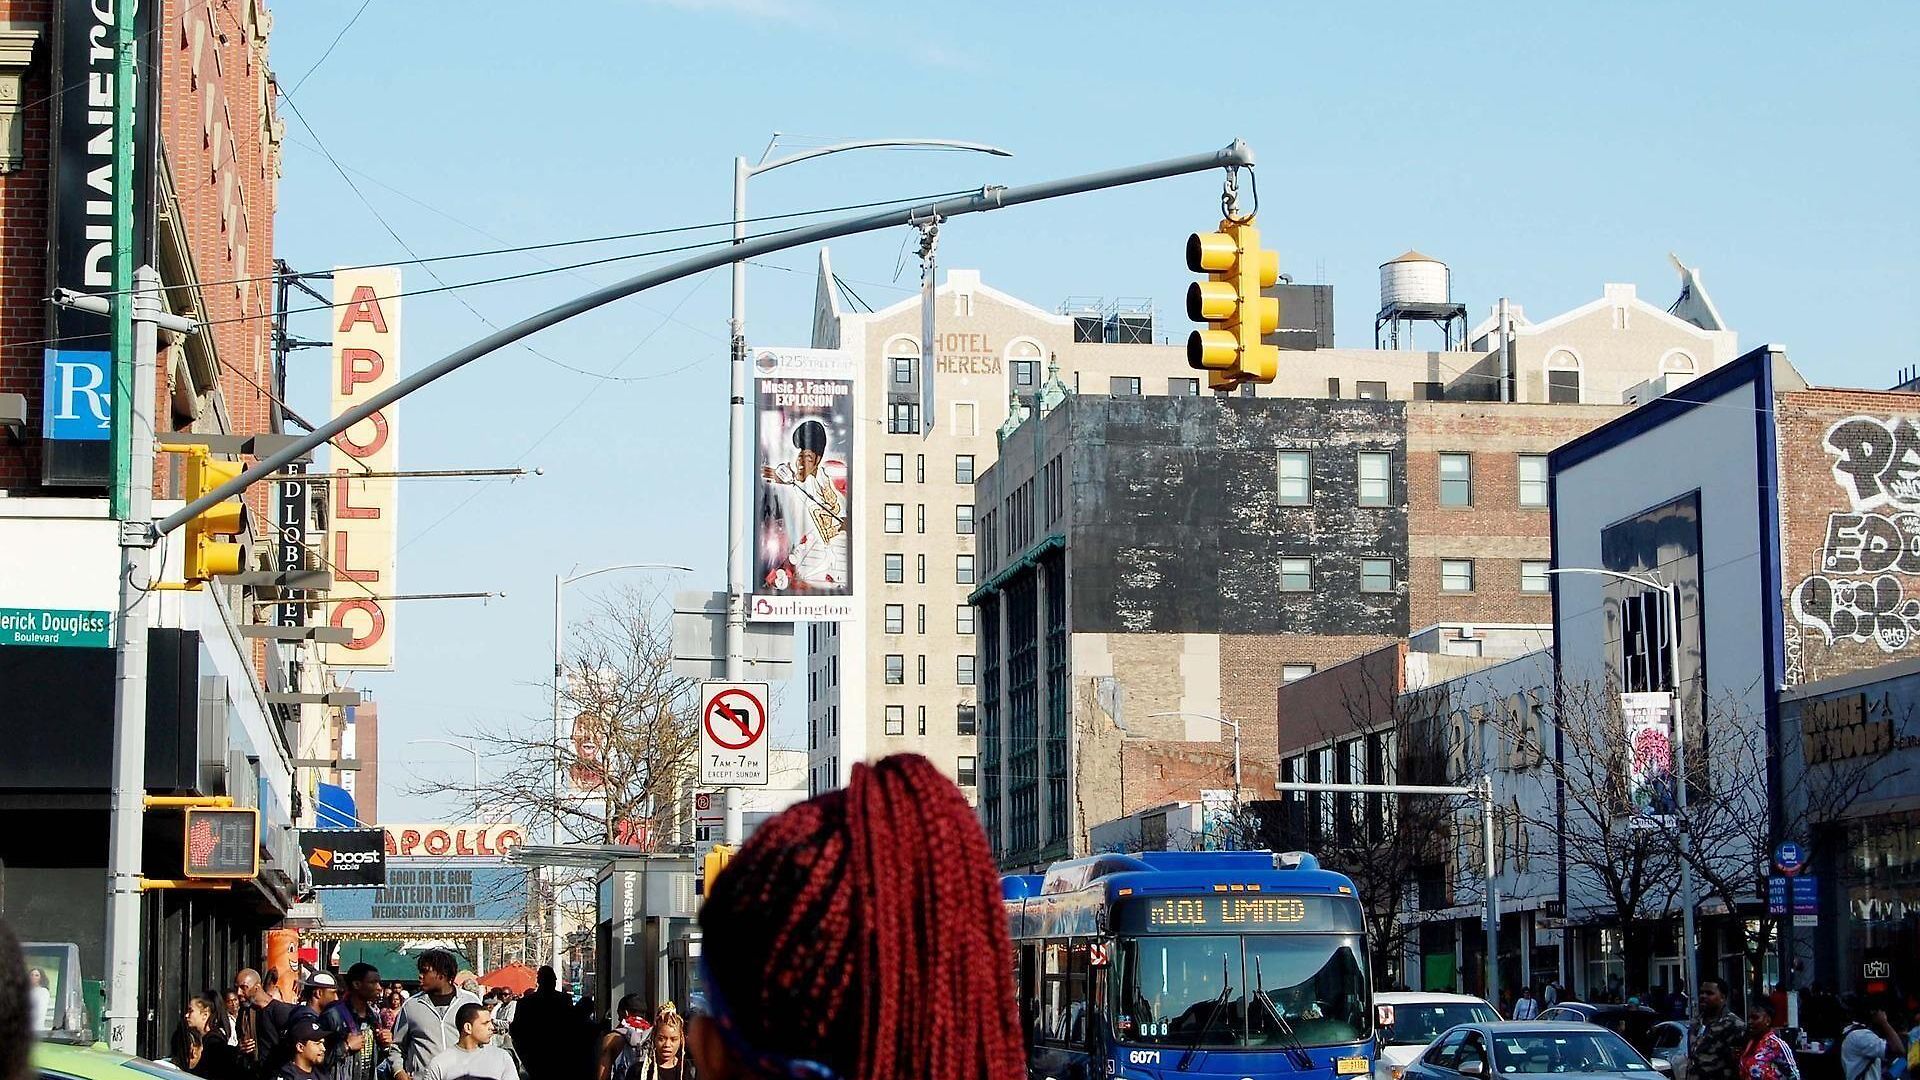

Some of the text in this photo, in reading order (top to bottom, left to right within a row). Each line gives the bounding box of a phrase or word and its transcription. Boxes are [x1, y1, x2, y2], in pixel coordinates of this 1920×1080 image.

[936, 355, 1002, 375] HERESA
[761, 380, 848, 396] Music & Fashion
[775, 394, 834, 407] EXPLOSION
[330, 285, 389, 651] APOLLO
[754, 599, 849, 619] Burlington
[0, 611, 104, 637] erick Douglass
[14, 631, 60, 644] Boulevard
[707, 771, 761, 779] EXCEPT SUNDAY
[385, 829, 522, 856] APOLLO
[333, 849, 381, 864] boost
[333, 863, 360, 871] mobile
[389, 870, 473, 885] GOOD OR BE GONE
[374, 886, 473, 904] AMATEUR NIGHT
[371, 905, 476, 919] WEDNESDAYS AT 7:30PM
[623, 869, 637, 946] Newsstand
[1221, 900, 1305, 923] LIMITED
[1129, 1050, 1160, 1064] 6071
